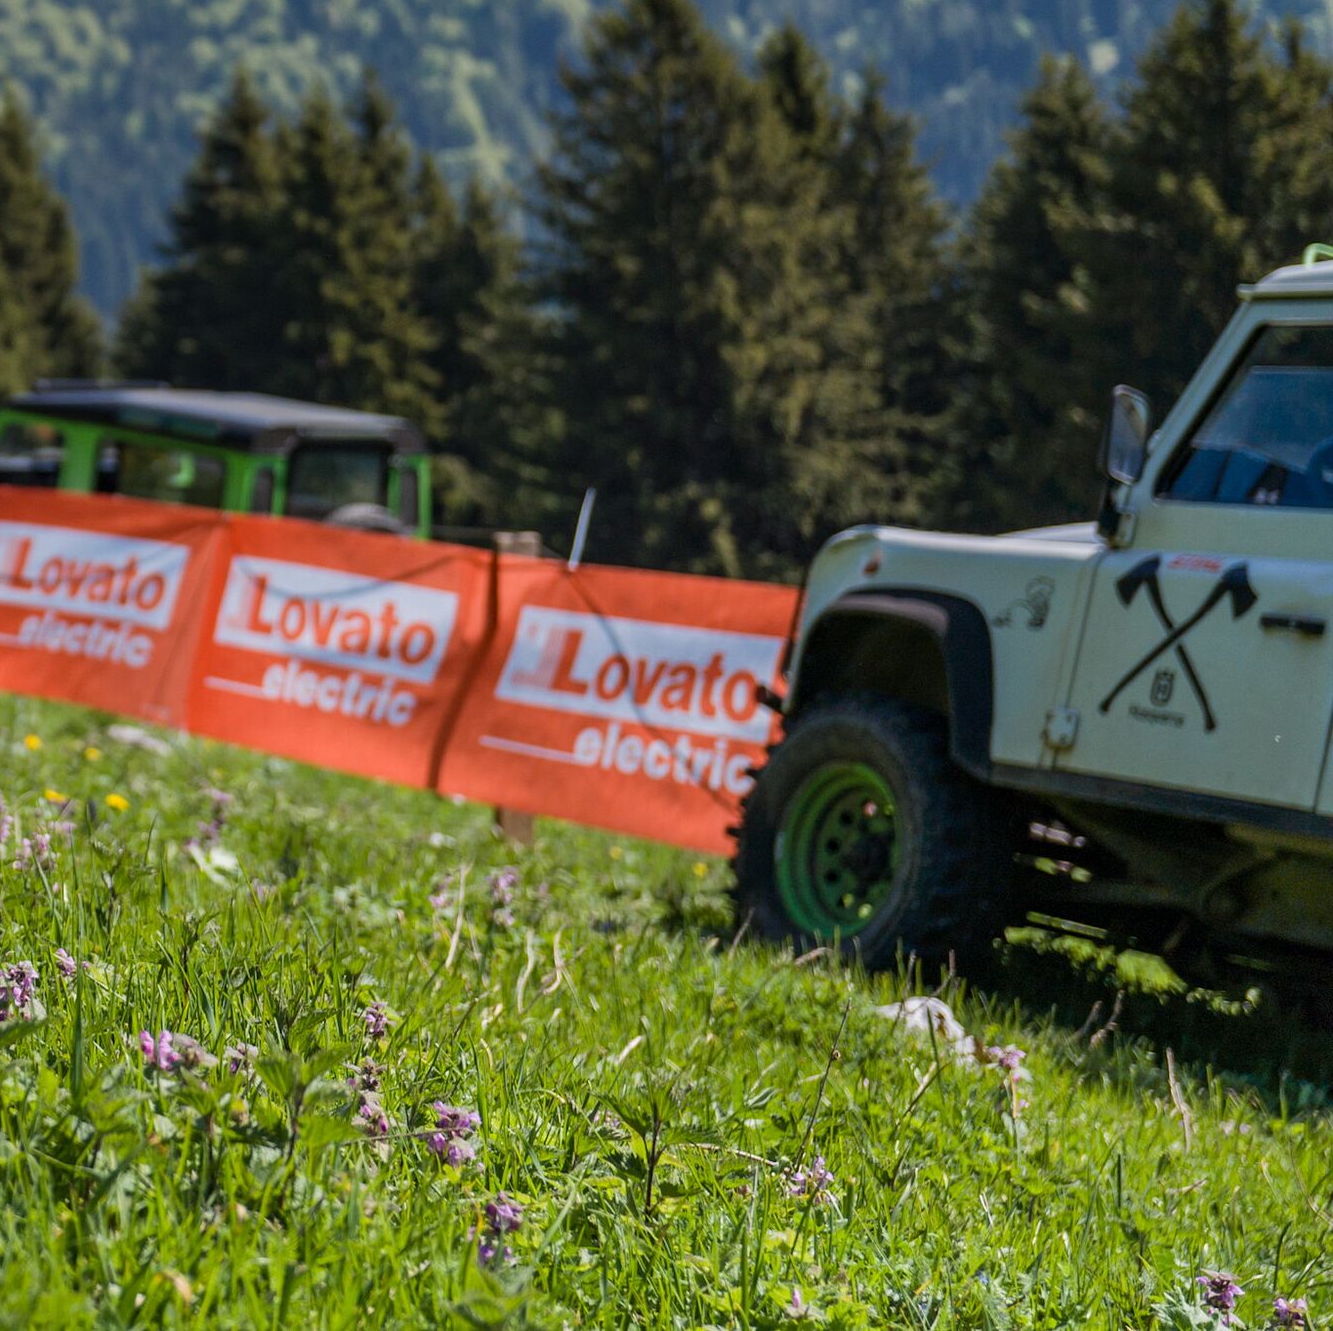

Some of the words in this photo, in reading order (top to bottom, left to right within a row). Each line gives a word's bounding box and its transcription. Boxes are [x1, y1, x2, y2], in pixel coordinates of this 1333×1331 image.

[5, 535, 167, 612] Lovato
[18, 609, 154, 668] electric
[247, 572, 437, 666] Lovato
[262, 658, 417, 727] electric
[549, 628, 758, 723] Lovato
[573, 720, 758, 797] electric
